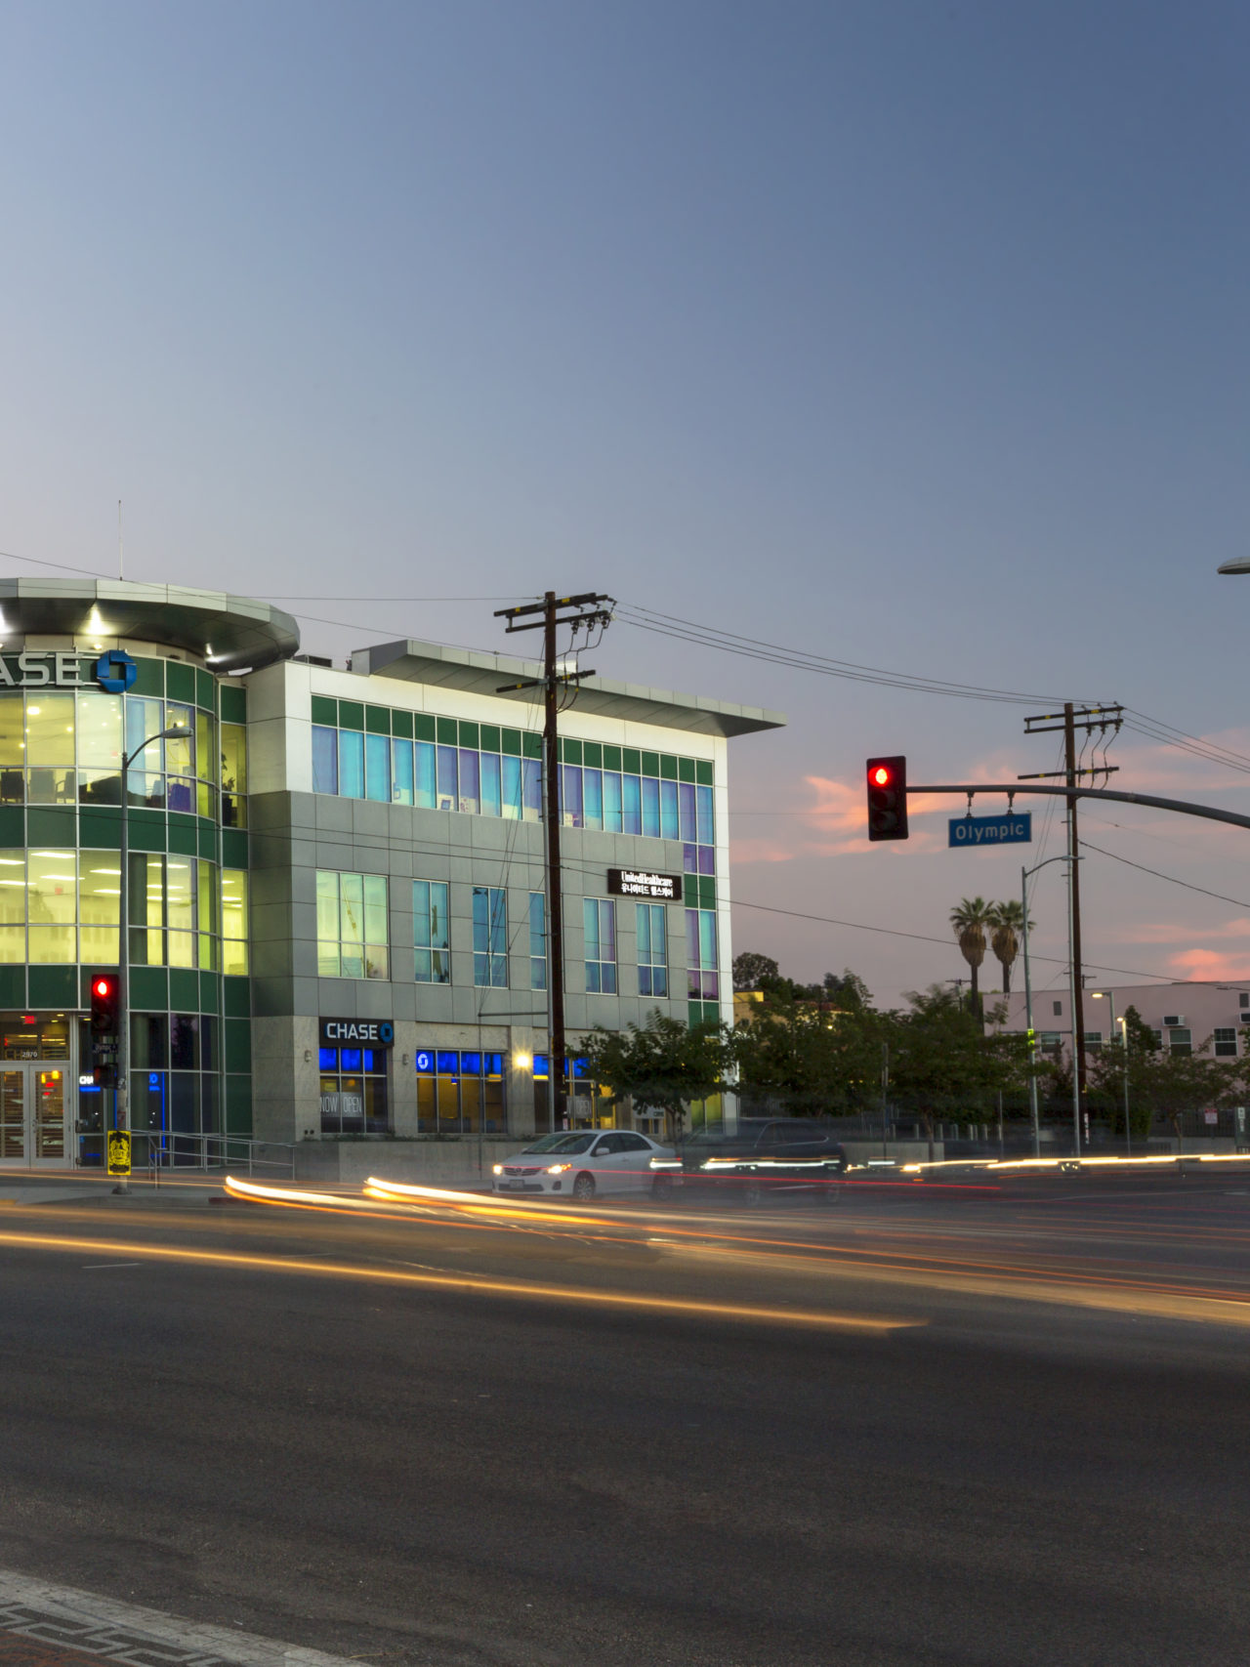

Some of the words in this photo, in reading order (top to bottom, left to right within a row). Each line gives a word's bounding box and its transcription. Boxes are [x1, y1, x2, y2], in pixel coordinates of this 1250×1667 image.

[955, 823, 1024, 842] Olympic
[326, 1022, 378, 1040] CHASE
[343, 1096, 363, 1113] OPEN
